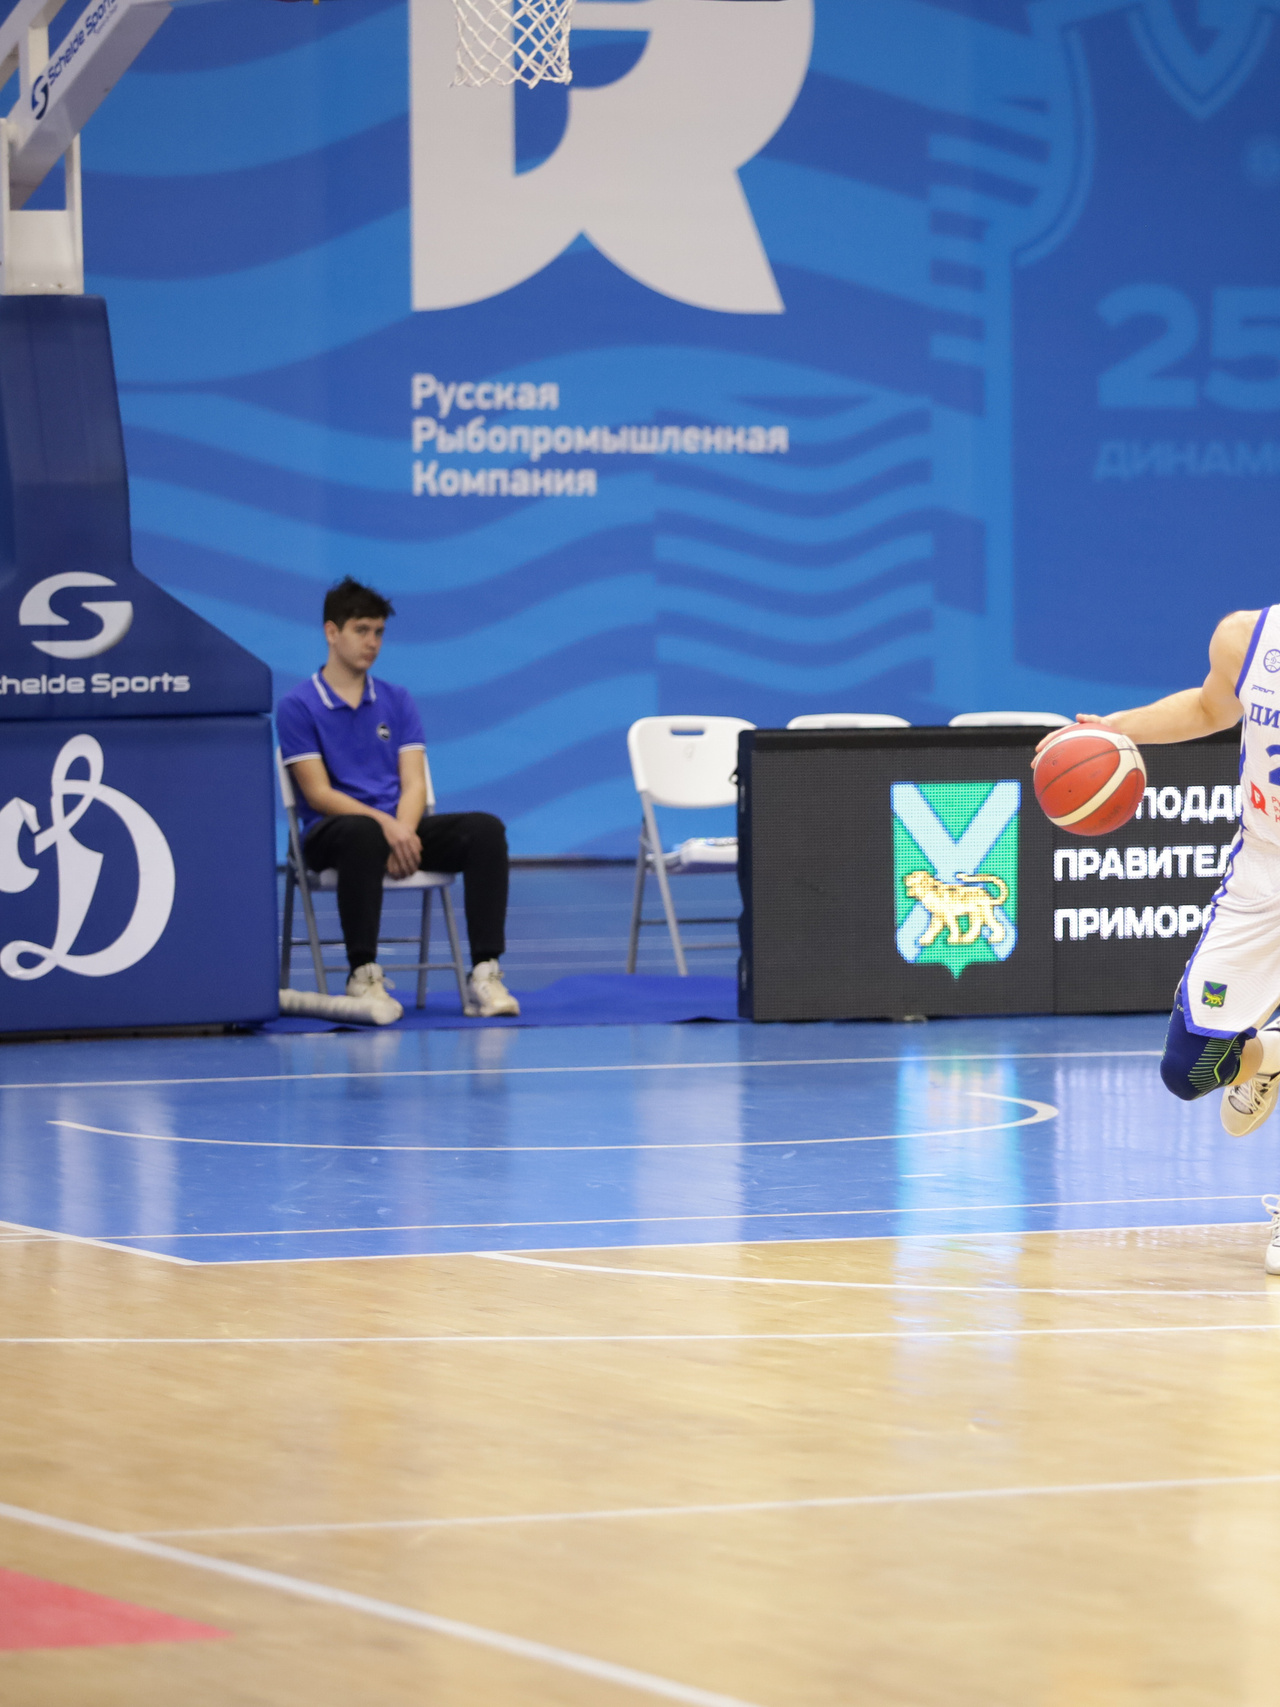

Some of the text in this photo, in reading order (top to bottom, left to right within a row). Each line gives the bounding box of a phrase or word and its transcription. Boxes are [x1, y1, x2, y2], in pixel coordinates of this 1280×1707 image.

[48, 29, 86, 86] Schelde
[411, 373, 560, 418] Русская
[411, 416, 789, 462] Рыбопромышленная
[411, 460, 598, 497] Компания
[91, 673, 191, 697] Sports
[1136, 785, 1243, 824] ПОДД
